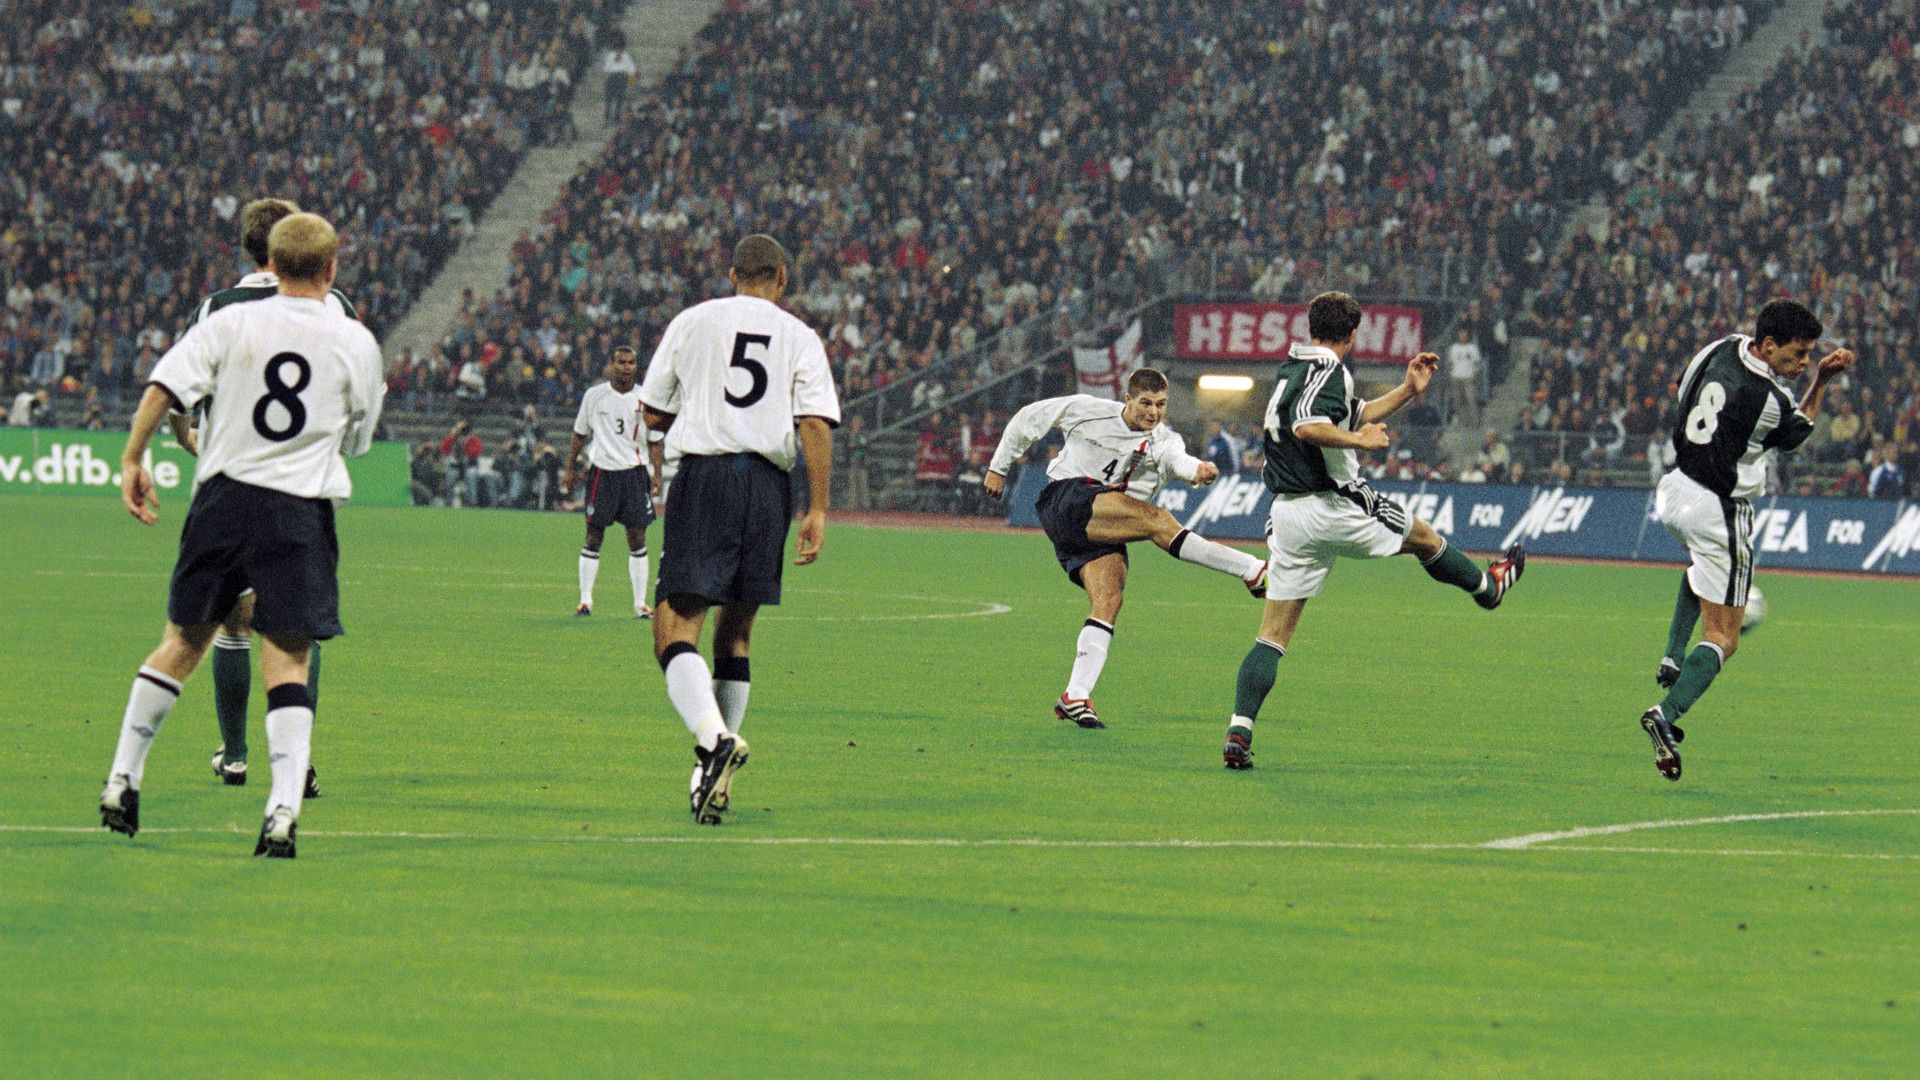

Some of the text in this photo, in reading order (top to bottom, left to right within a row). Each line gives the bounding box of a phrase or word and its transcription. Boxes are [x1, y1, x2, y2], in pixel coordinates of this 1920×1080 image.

[724, 332, 771, 408] 5
[252, 352, 312, 442] 8
[1685, 381, 1726, 445] 8
[615, 419, 624, 435] 3
[1102, 459, 1118, 481] 4
[1469, 504, 1503, 527] FOR
[1826, 520, 1865, 545] FOR
